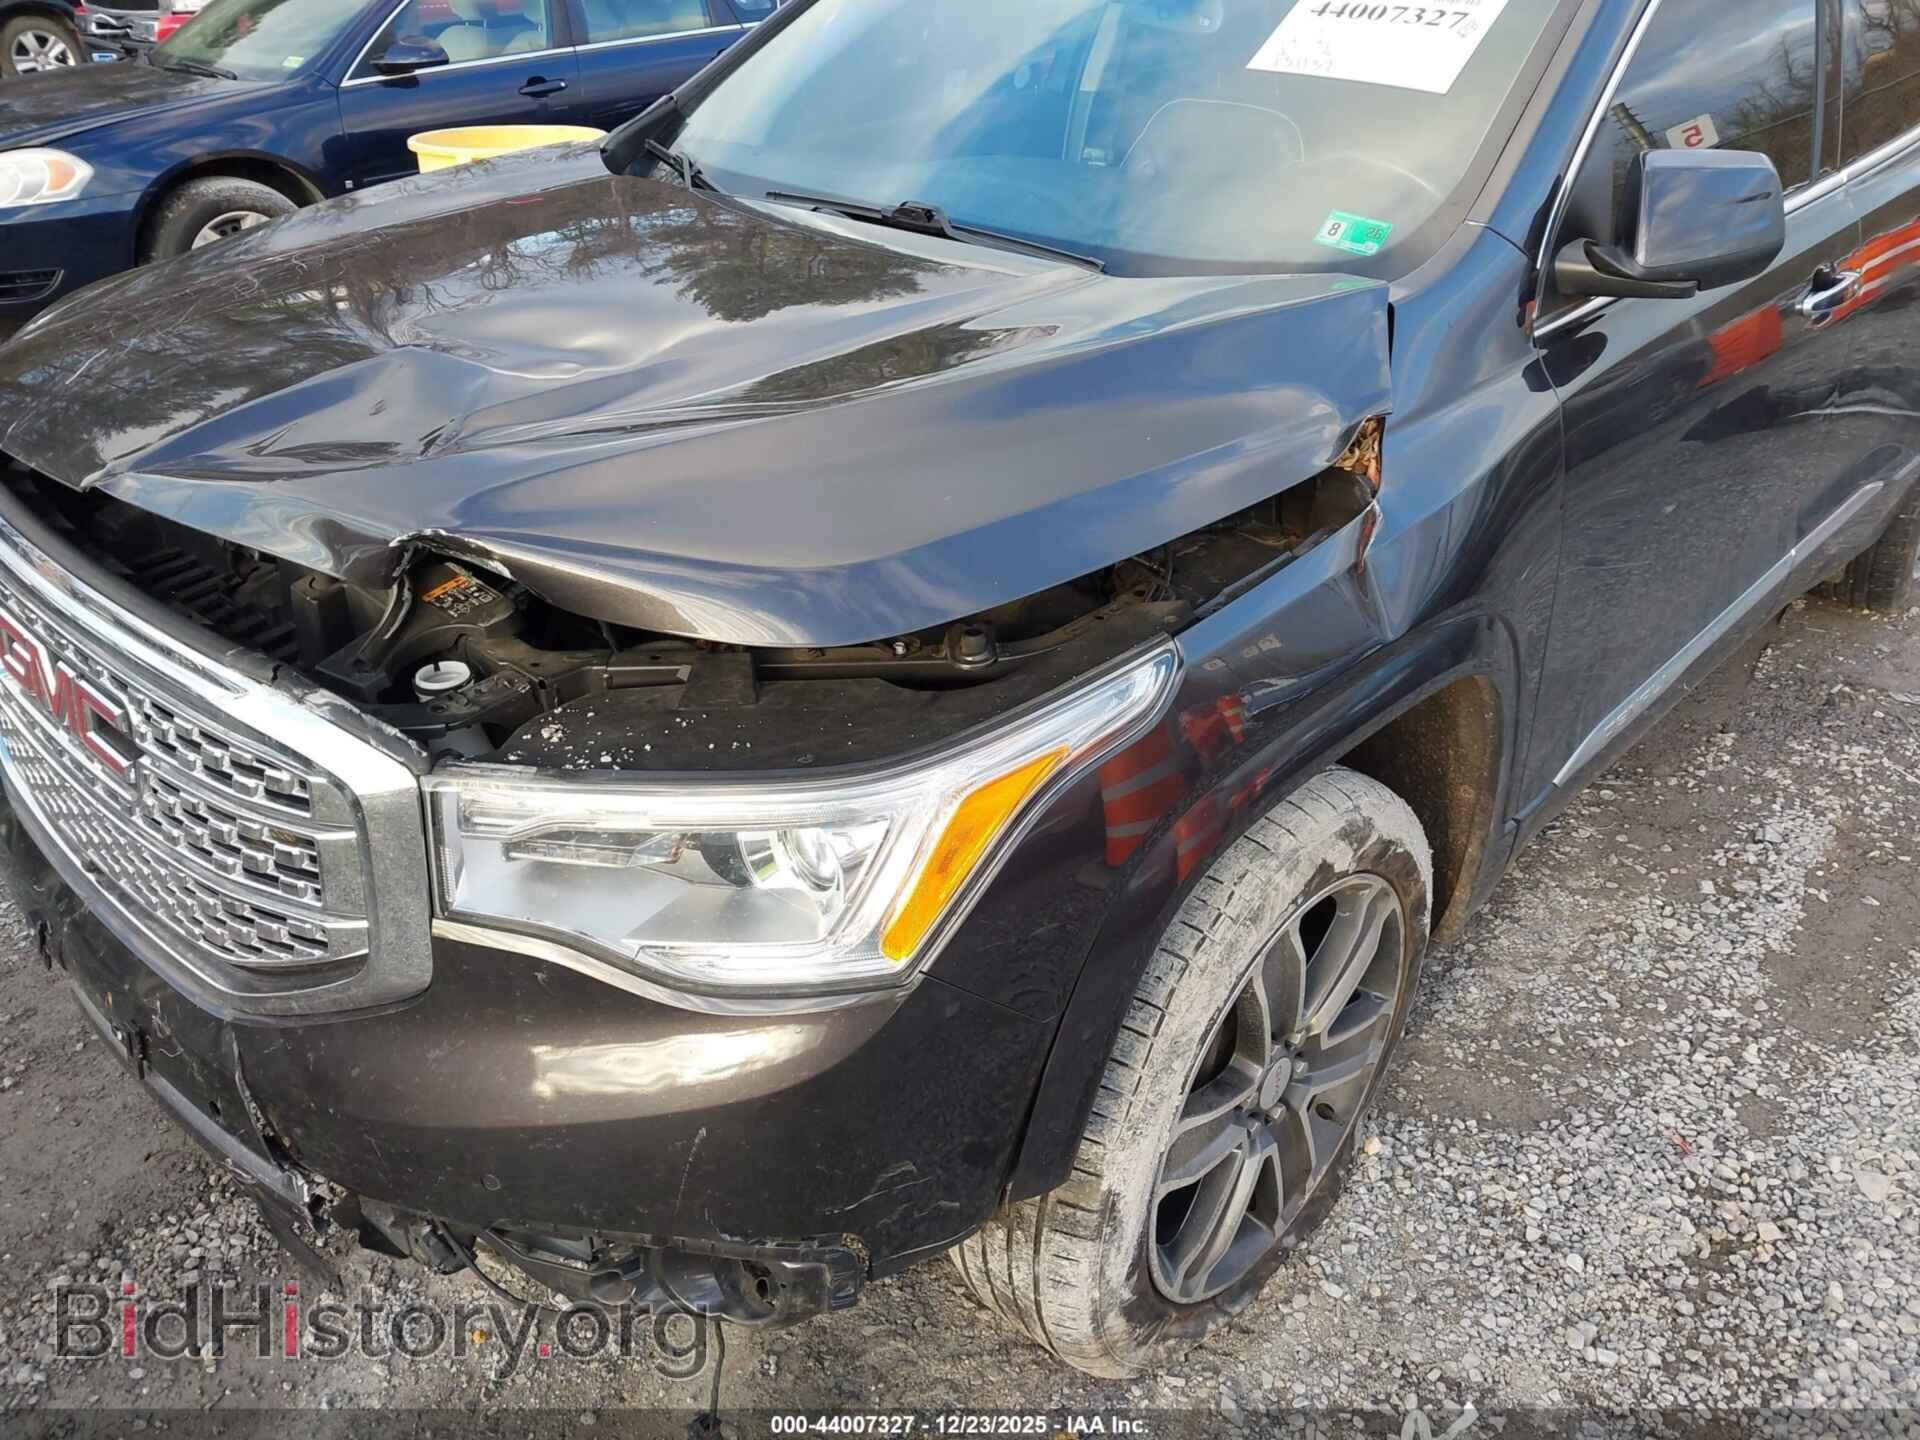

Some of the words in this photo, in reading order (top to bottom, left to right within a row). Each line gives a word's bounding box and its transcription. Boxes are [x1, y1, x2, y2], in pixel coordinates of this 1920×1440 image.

[1310, 1, 1469, 30] 44007327
[1327, 222, 1342, 237] 8
[0, 607, 132, 778] GMC
